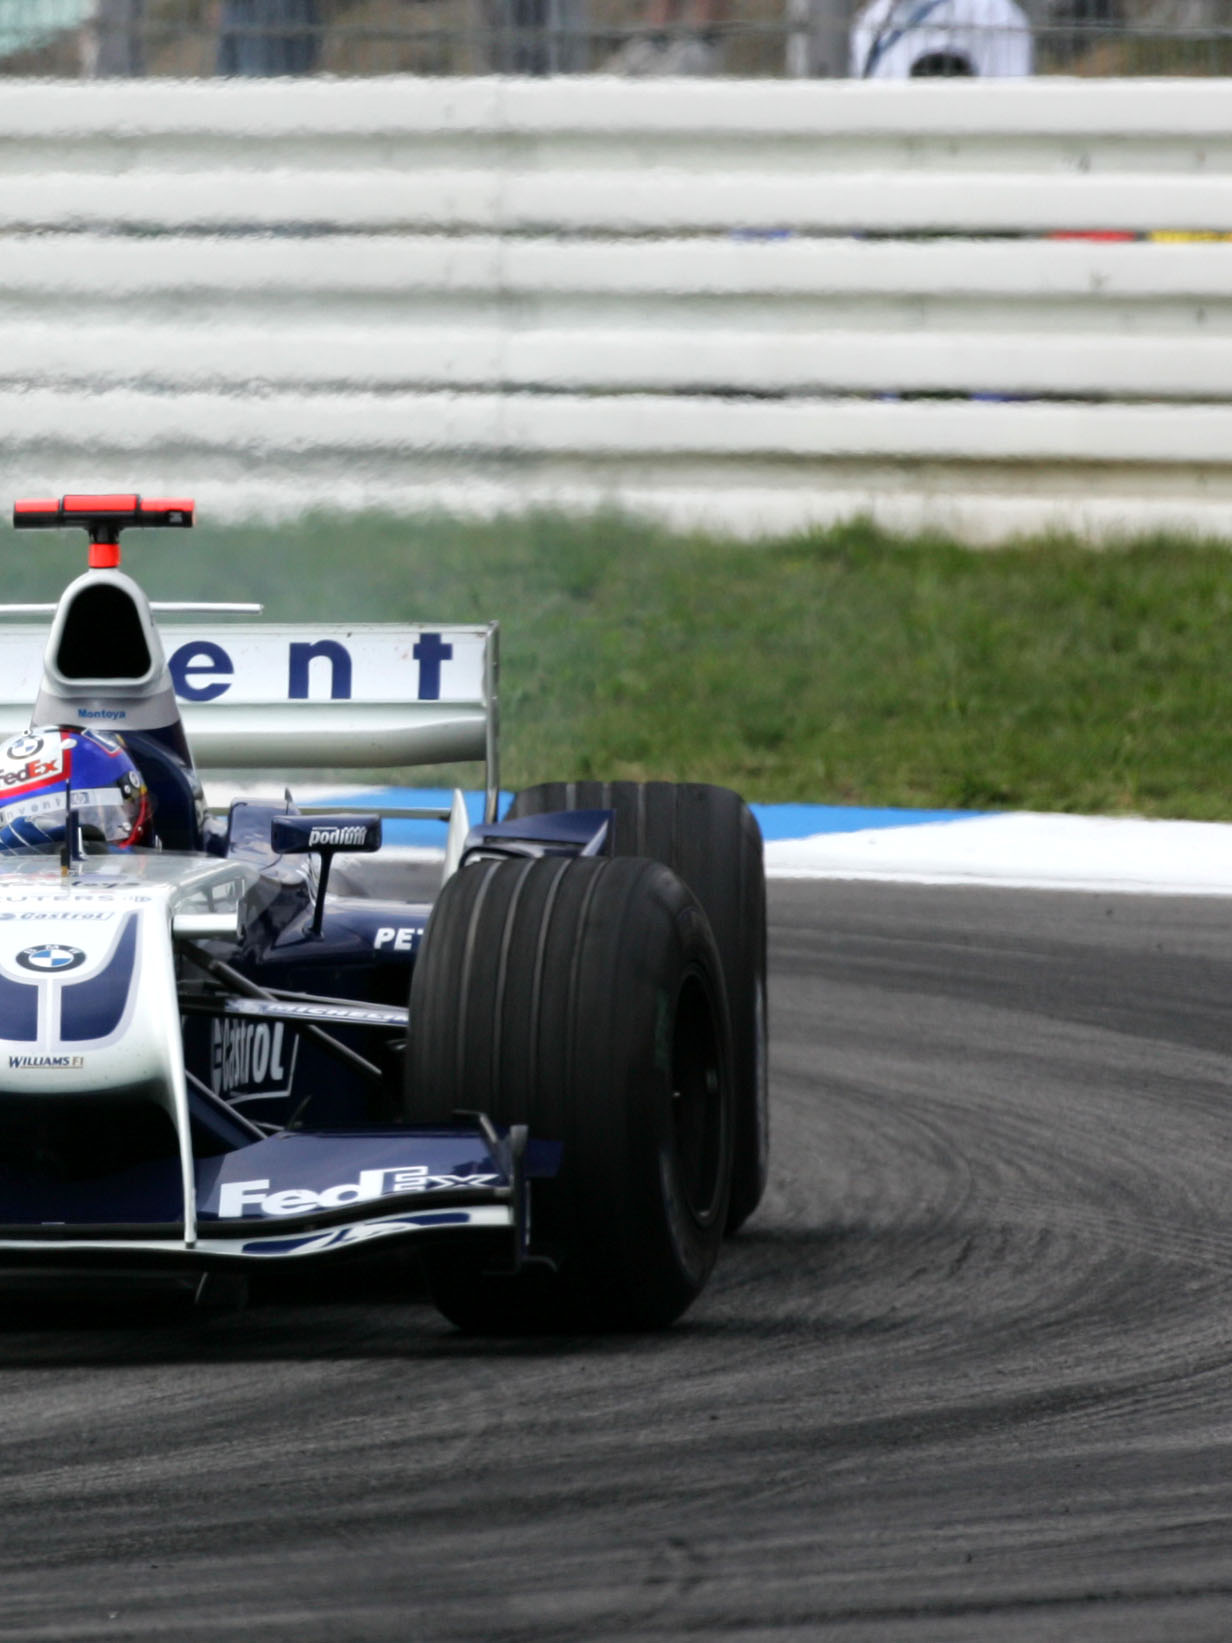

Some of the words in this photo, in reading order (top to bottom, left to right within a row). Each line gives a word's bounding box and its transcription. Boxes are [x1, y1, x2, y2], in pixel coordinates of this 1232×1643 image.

[77, 708, 126, 720] Montoya
[308, 826, 367, 847] podium
[20, 911, 104, 921] Castrol
[218, 1166, 499, 1218] FedEx
